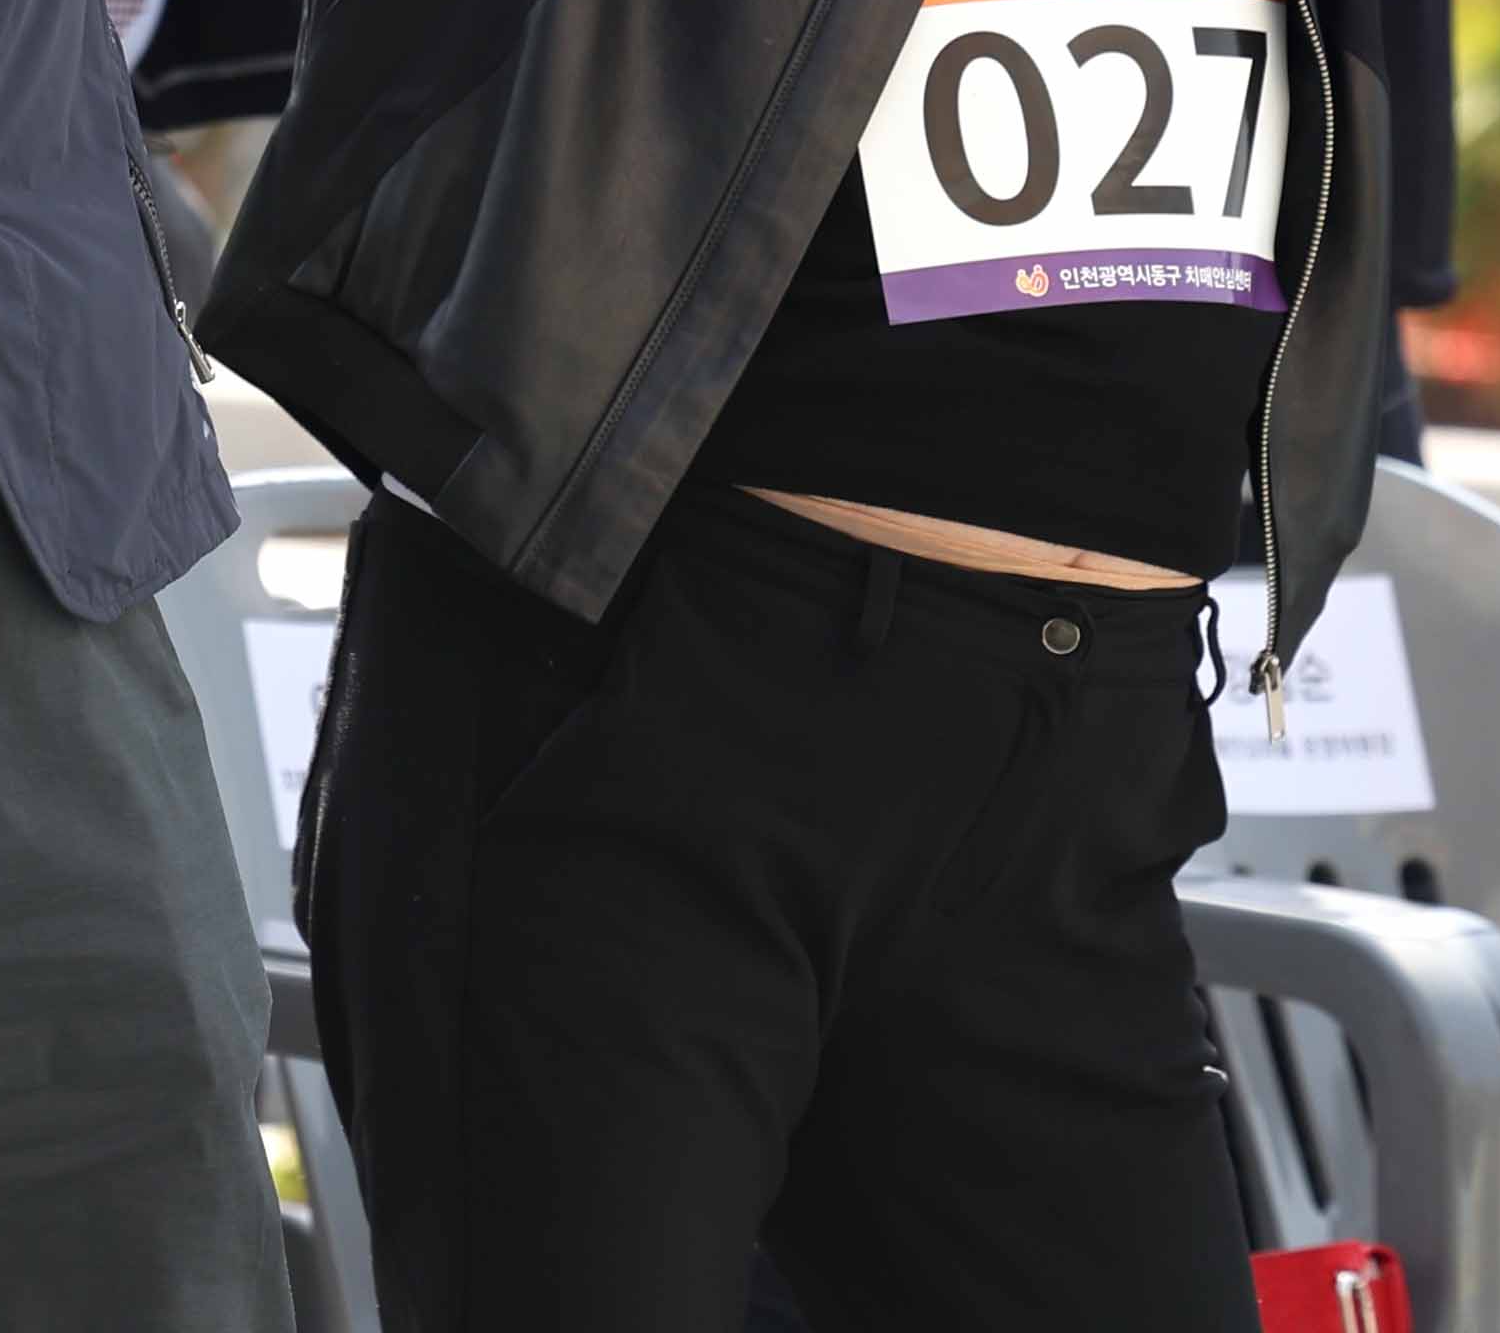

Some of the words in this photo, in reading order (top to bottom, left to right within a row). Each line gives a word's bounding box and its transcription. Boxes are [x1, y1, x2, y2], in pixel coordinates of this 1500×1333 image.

[924, 24, 1268, 227] 027
[1059, 264, 1181, 291] 인천광역시동구
[1184, 265, 1252, 292] 치매안심센터
